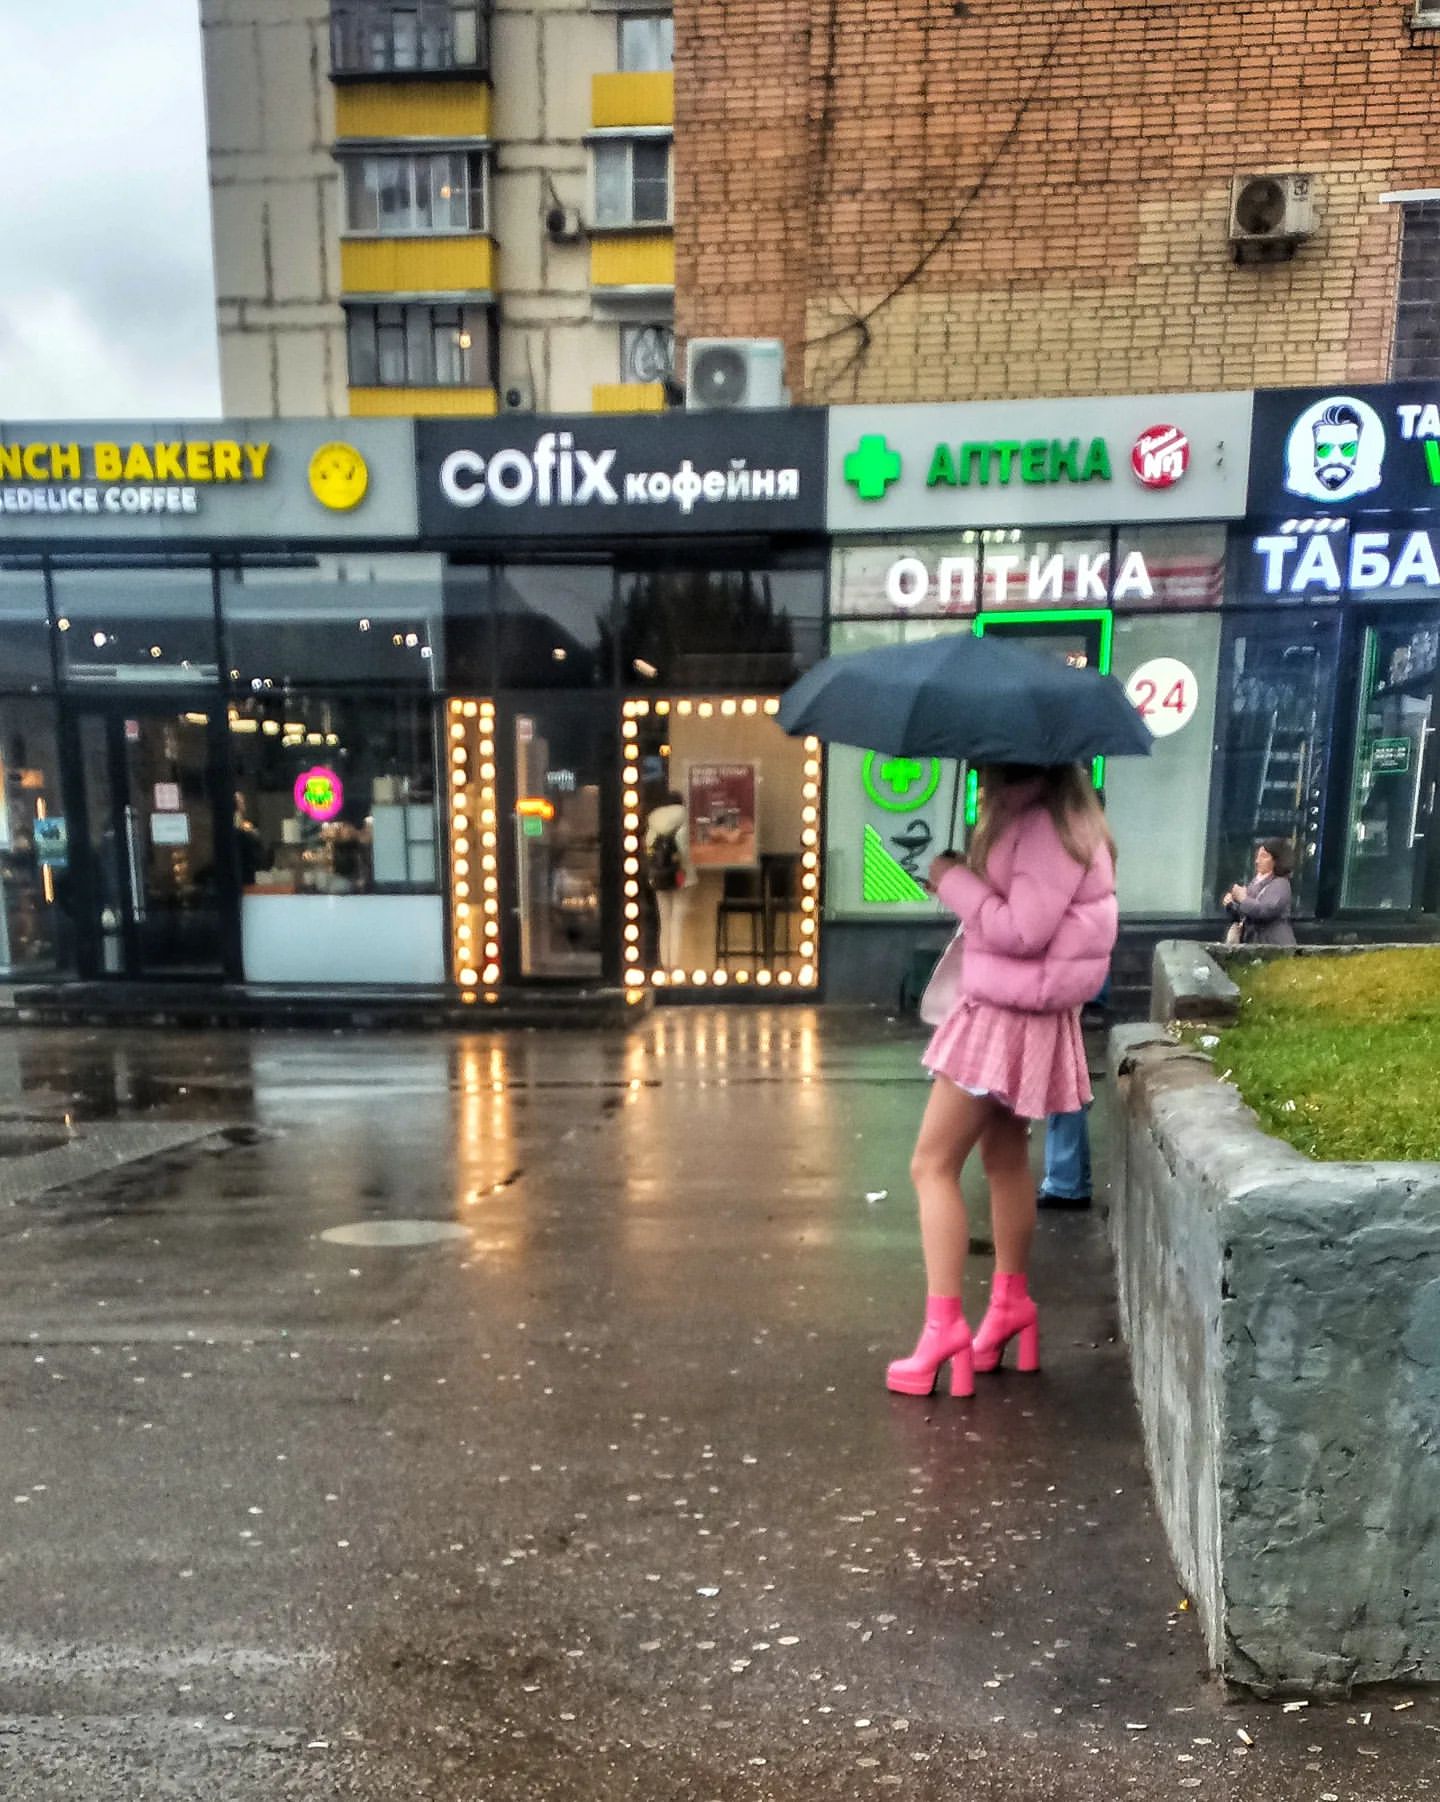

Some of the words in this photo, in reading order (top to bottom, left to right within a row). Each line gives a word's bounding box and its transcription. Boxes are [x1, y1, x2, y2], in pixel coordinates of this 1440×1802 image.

[94, 441, 271, 480] BAKERY
[440, 432, 619, 507] cofix
[624, 459, 800, 515] кофейня
[926, 436, 1113, 487] АПТЕКА
[0, 488, 99, 513] EDELICE
[104, 487, 198, 513] COFFEE
[886, 550, 1154, 608] ОПТИКА
[1253, 531, 1440, 594] ТАБА
[1135, 679, 1186, 717] 24
